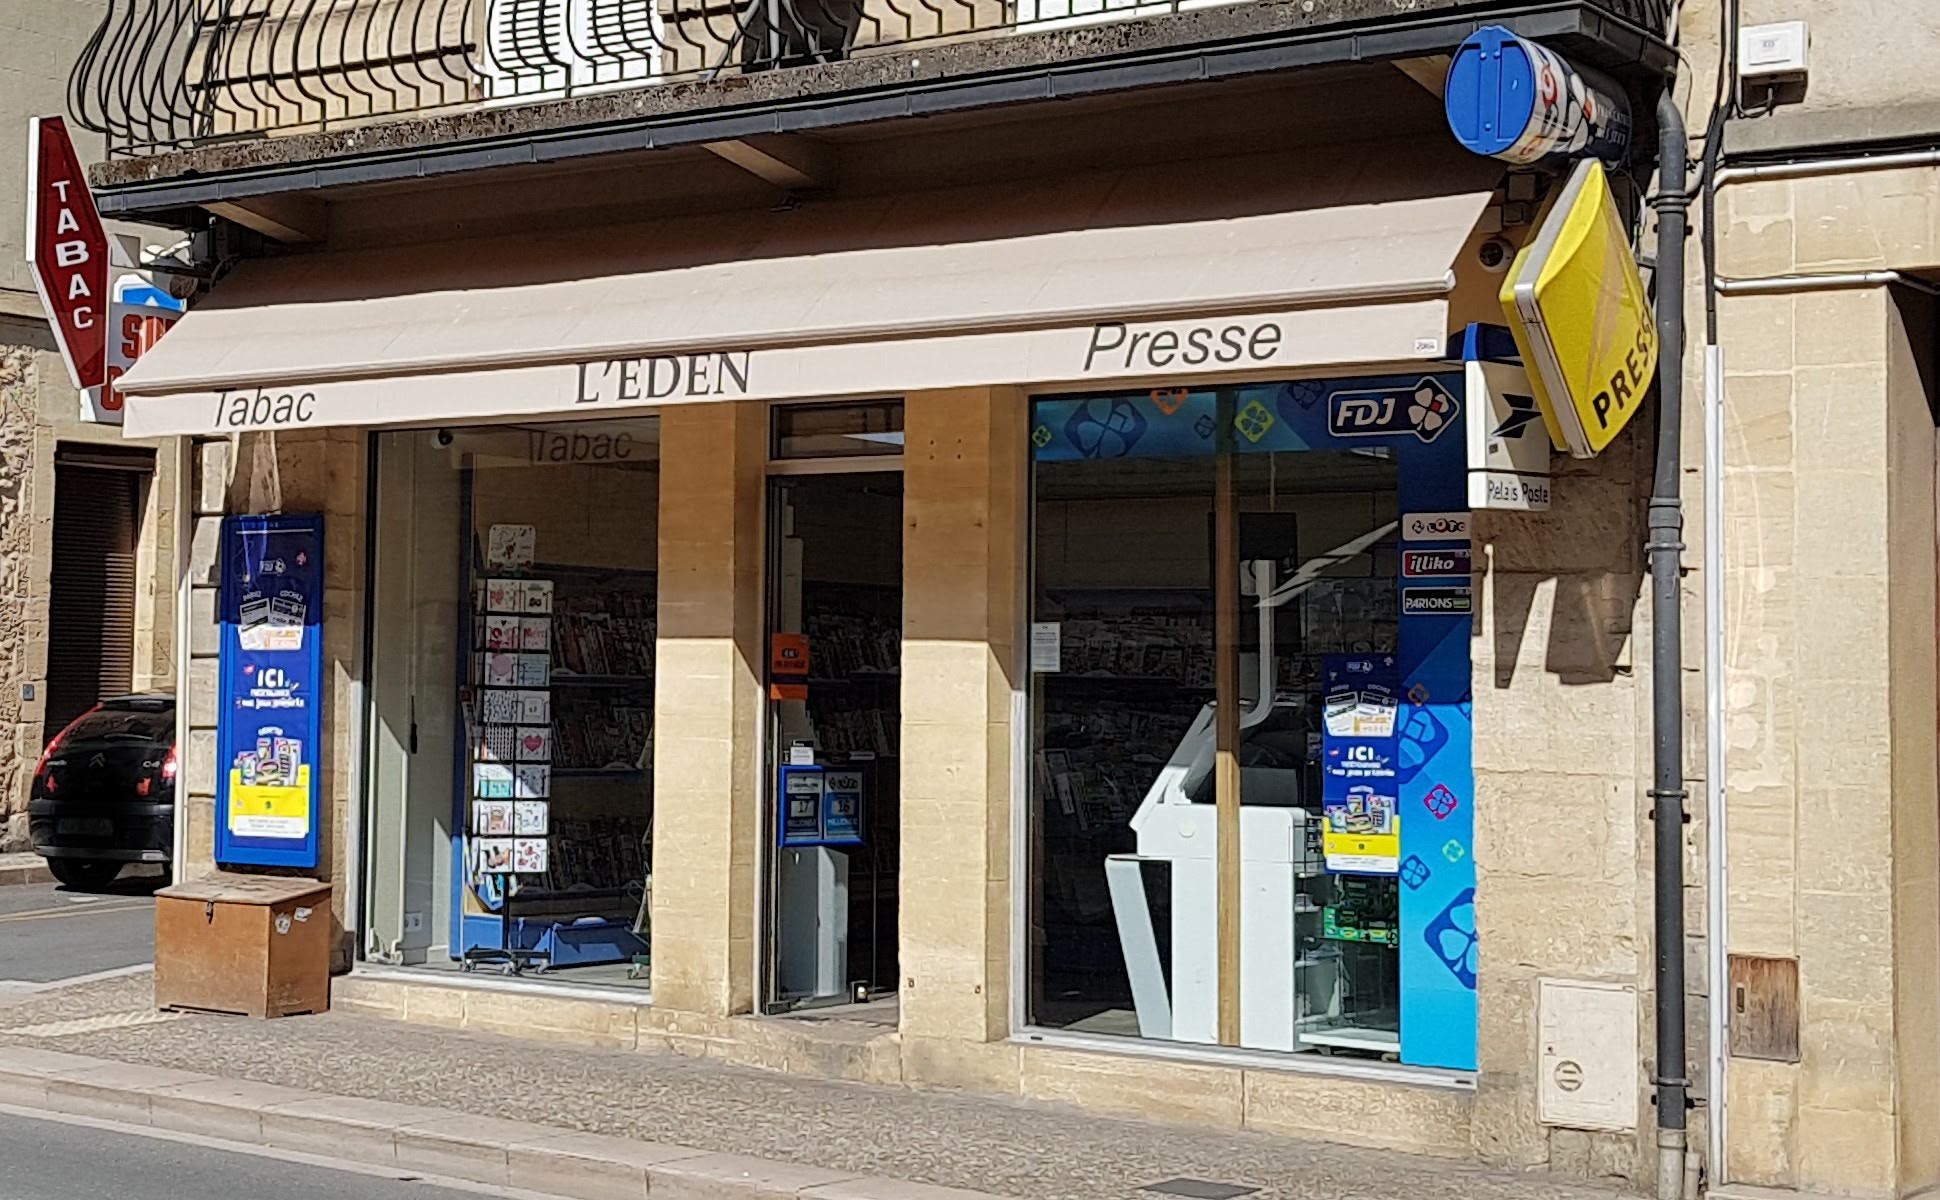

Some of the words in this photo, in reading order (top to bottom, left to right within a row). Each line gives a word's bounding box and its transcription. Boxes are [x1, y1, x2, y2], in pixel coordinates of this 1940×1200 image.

[52, 180, 94, 329] TABAC
[1083, 322, 1282, 371] Presse
[575, 351, 750, 404] L'EDEN
[214, 386, 315, 427] Tabac
[1336, 398, 1396, 427] FDJ
[1521, 482, 1548, 503] Poste
[1427, 518, 1467, 533] LOTO
[1405, 597, 1453, 609] PARIONS
[257, 668, 284, 687] ICI
[1347, 745, 1374, 761] ICI
